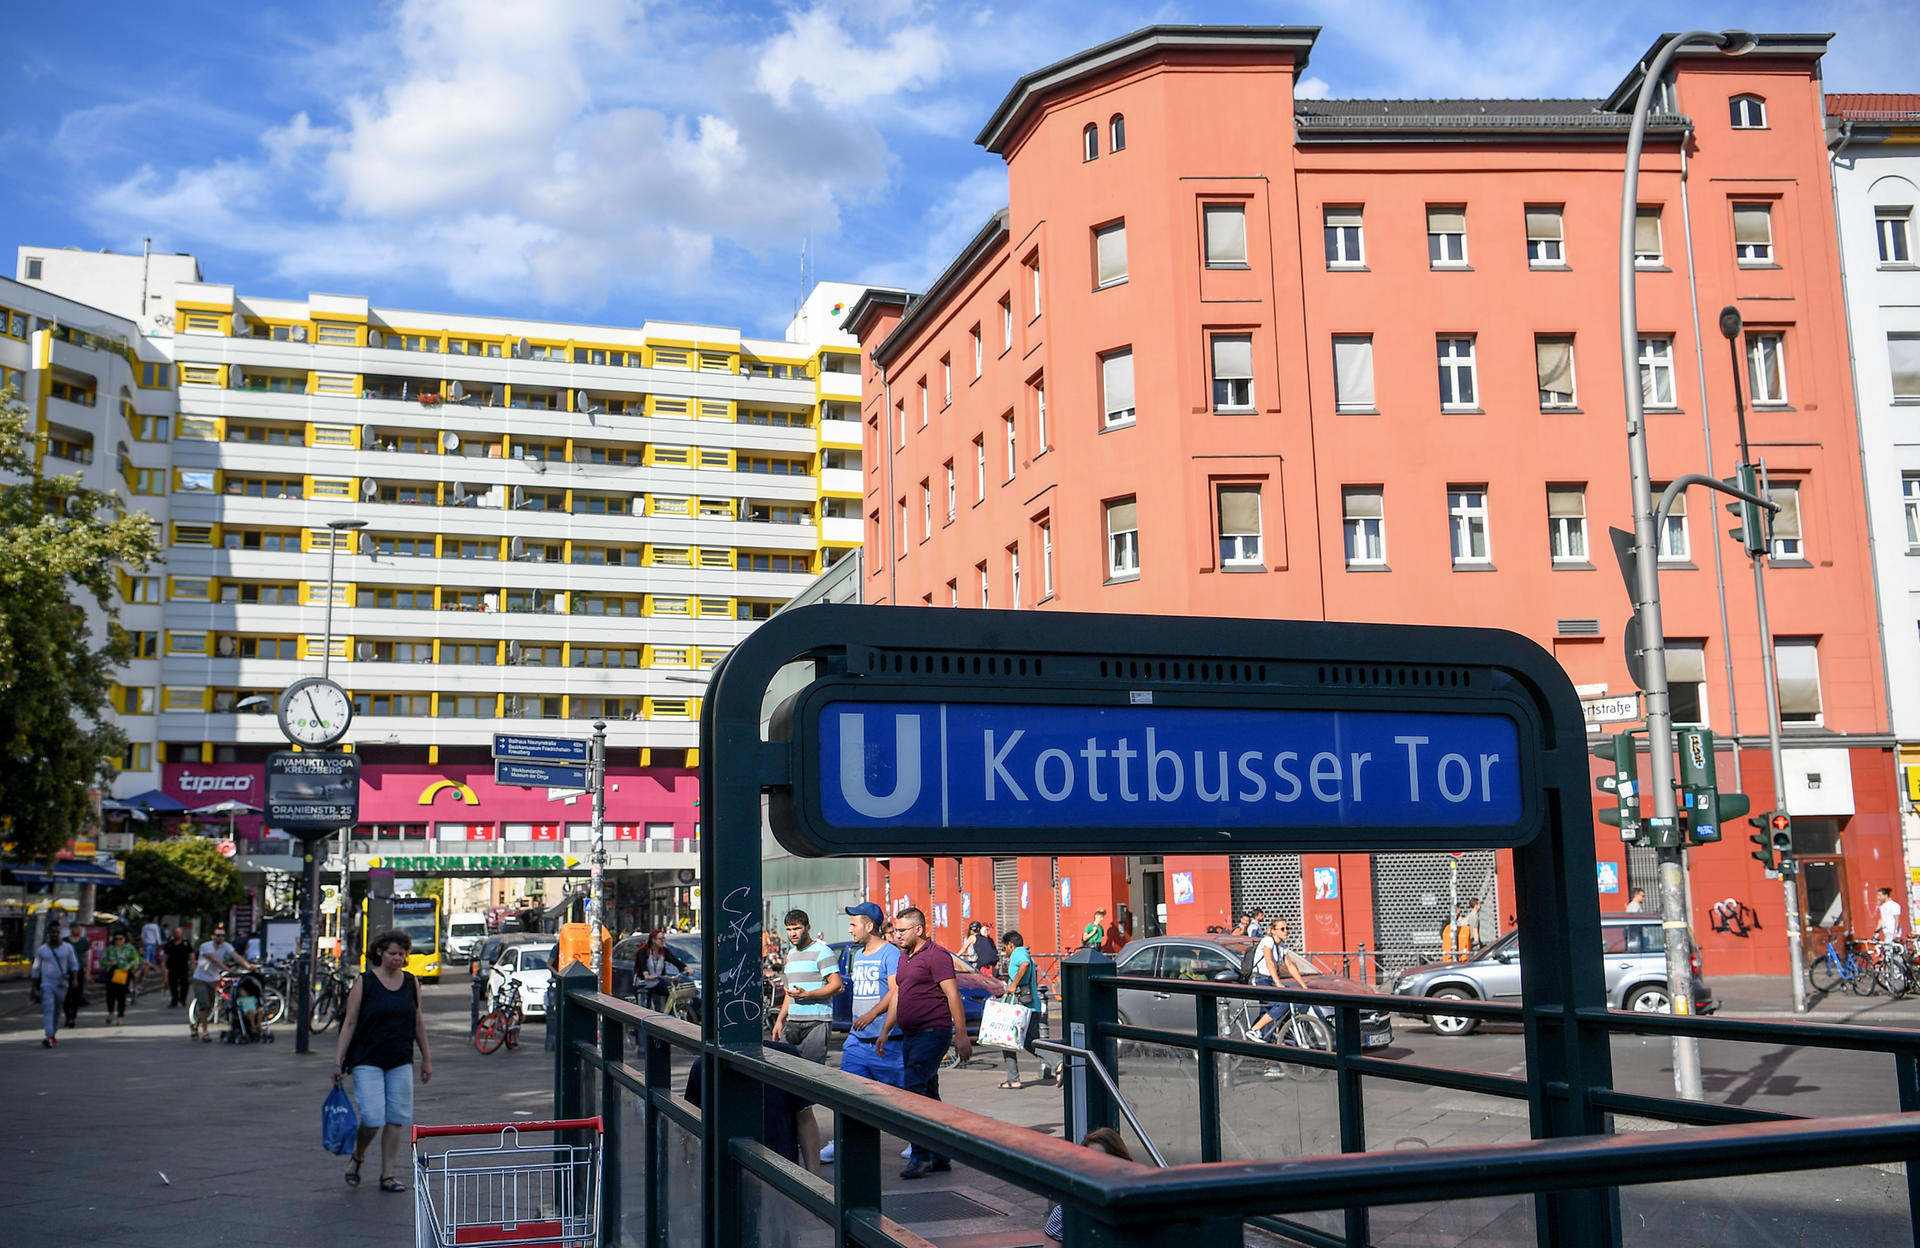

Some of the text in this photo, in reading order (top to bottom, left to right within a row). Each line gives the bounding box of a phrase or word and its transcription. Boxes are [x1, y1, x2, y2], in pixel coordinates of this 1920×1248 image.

[273, 759, 324, 767] JIVAMUKTI
[840, 713, 1499, 818] U Kottbusser Tor
[284, 766, 342, 774] KREUZBERG
[179, 770, 251, 794] tipico
[272, 805, 352, 814] ORANIENSTR. 25
[384, 855, 564, 870] ZENTRUM KREUZBERG
